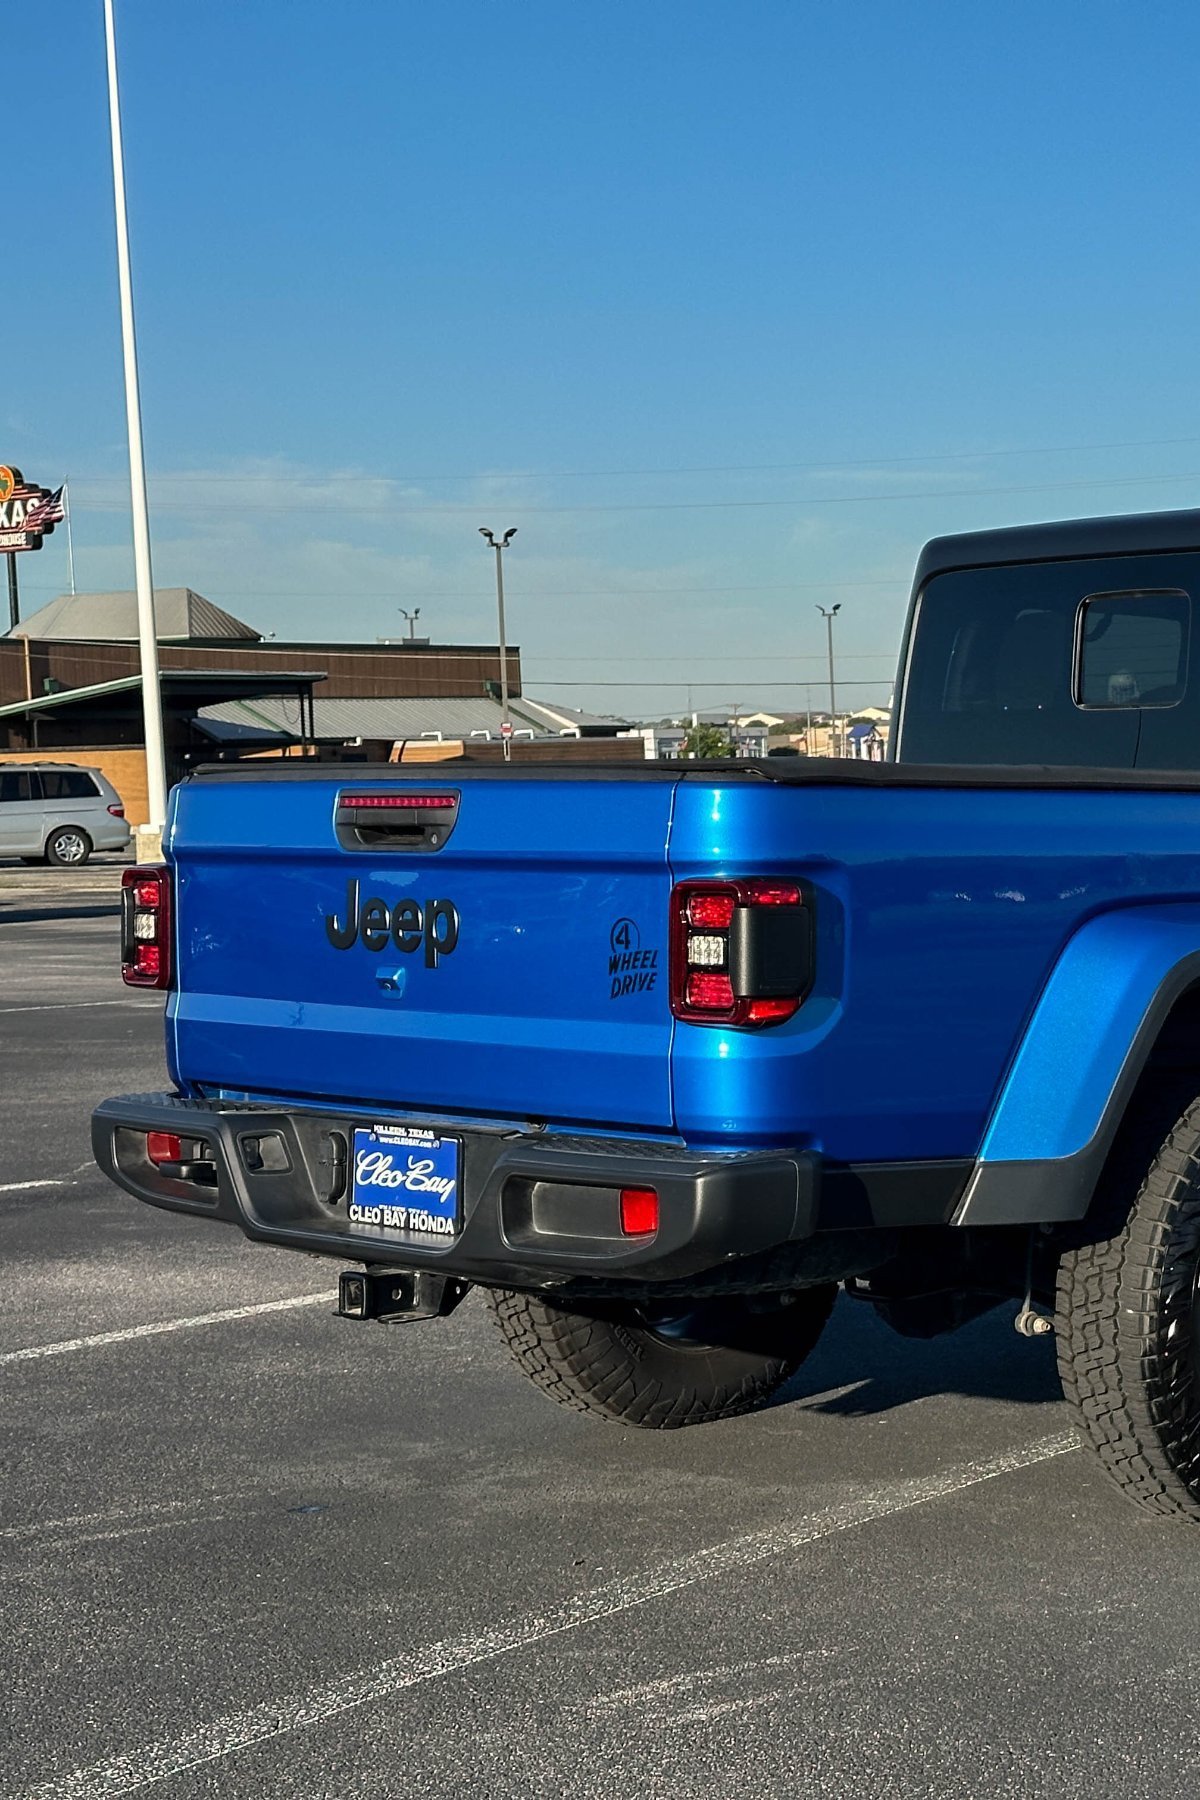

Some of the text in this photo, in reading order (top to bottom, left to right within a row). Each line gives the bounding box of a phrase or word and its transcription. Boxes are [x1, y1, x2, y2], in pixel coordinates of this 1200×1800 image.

[325, 879, 460, 968] Jeep
[609, 949, 658, 976] WHEEL
[610, 972, 657, 999] DRIVE
[408, 1128, 435, 1139] TEXAS
[356, 1149, 456, 1203] Cleo Bay
[349, 1204, 380, 1224] CLEO
[383, 1209, 407, 1228] BAY
[409, 1213, 455, 1235] HONDA
